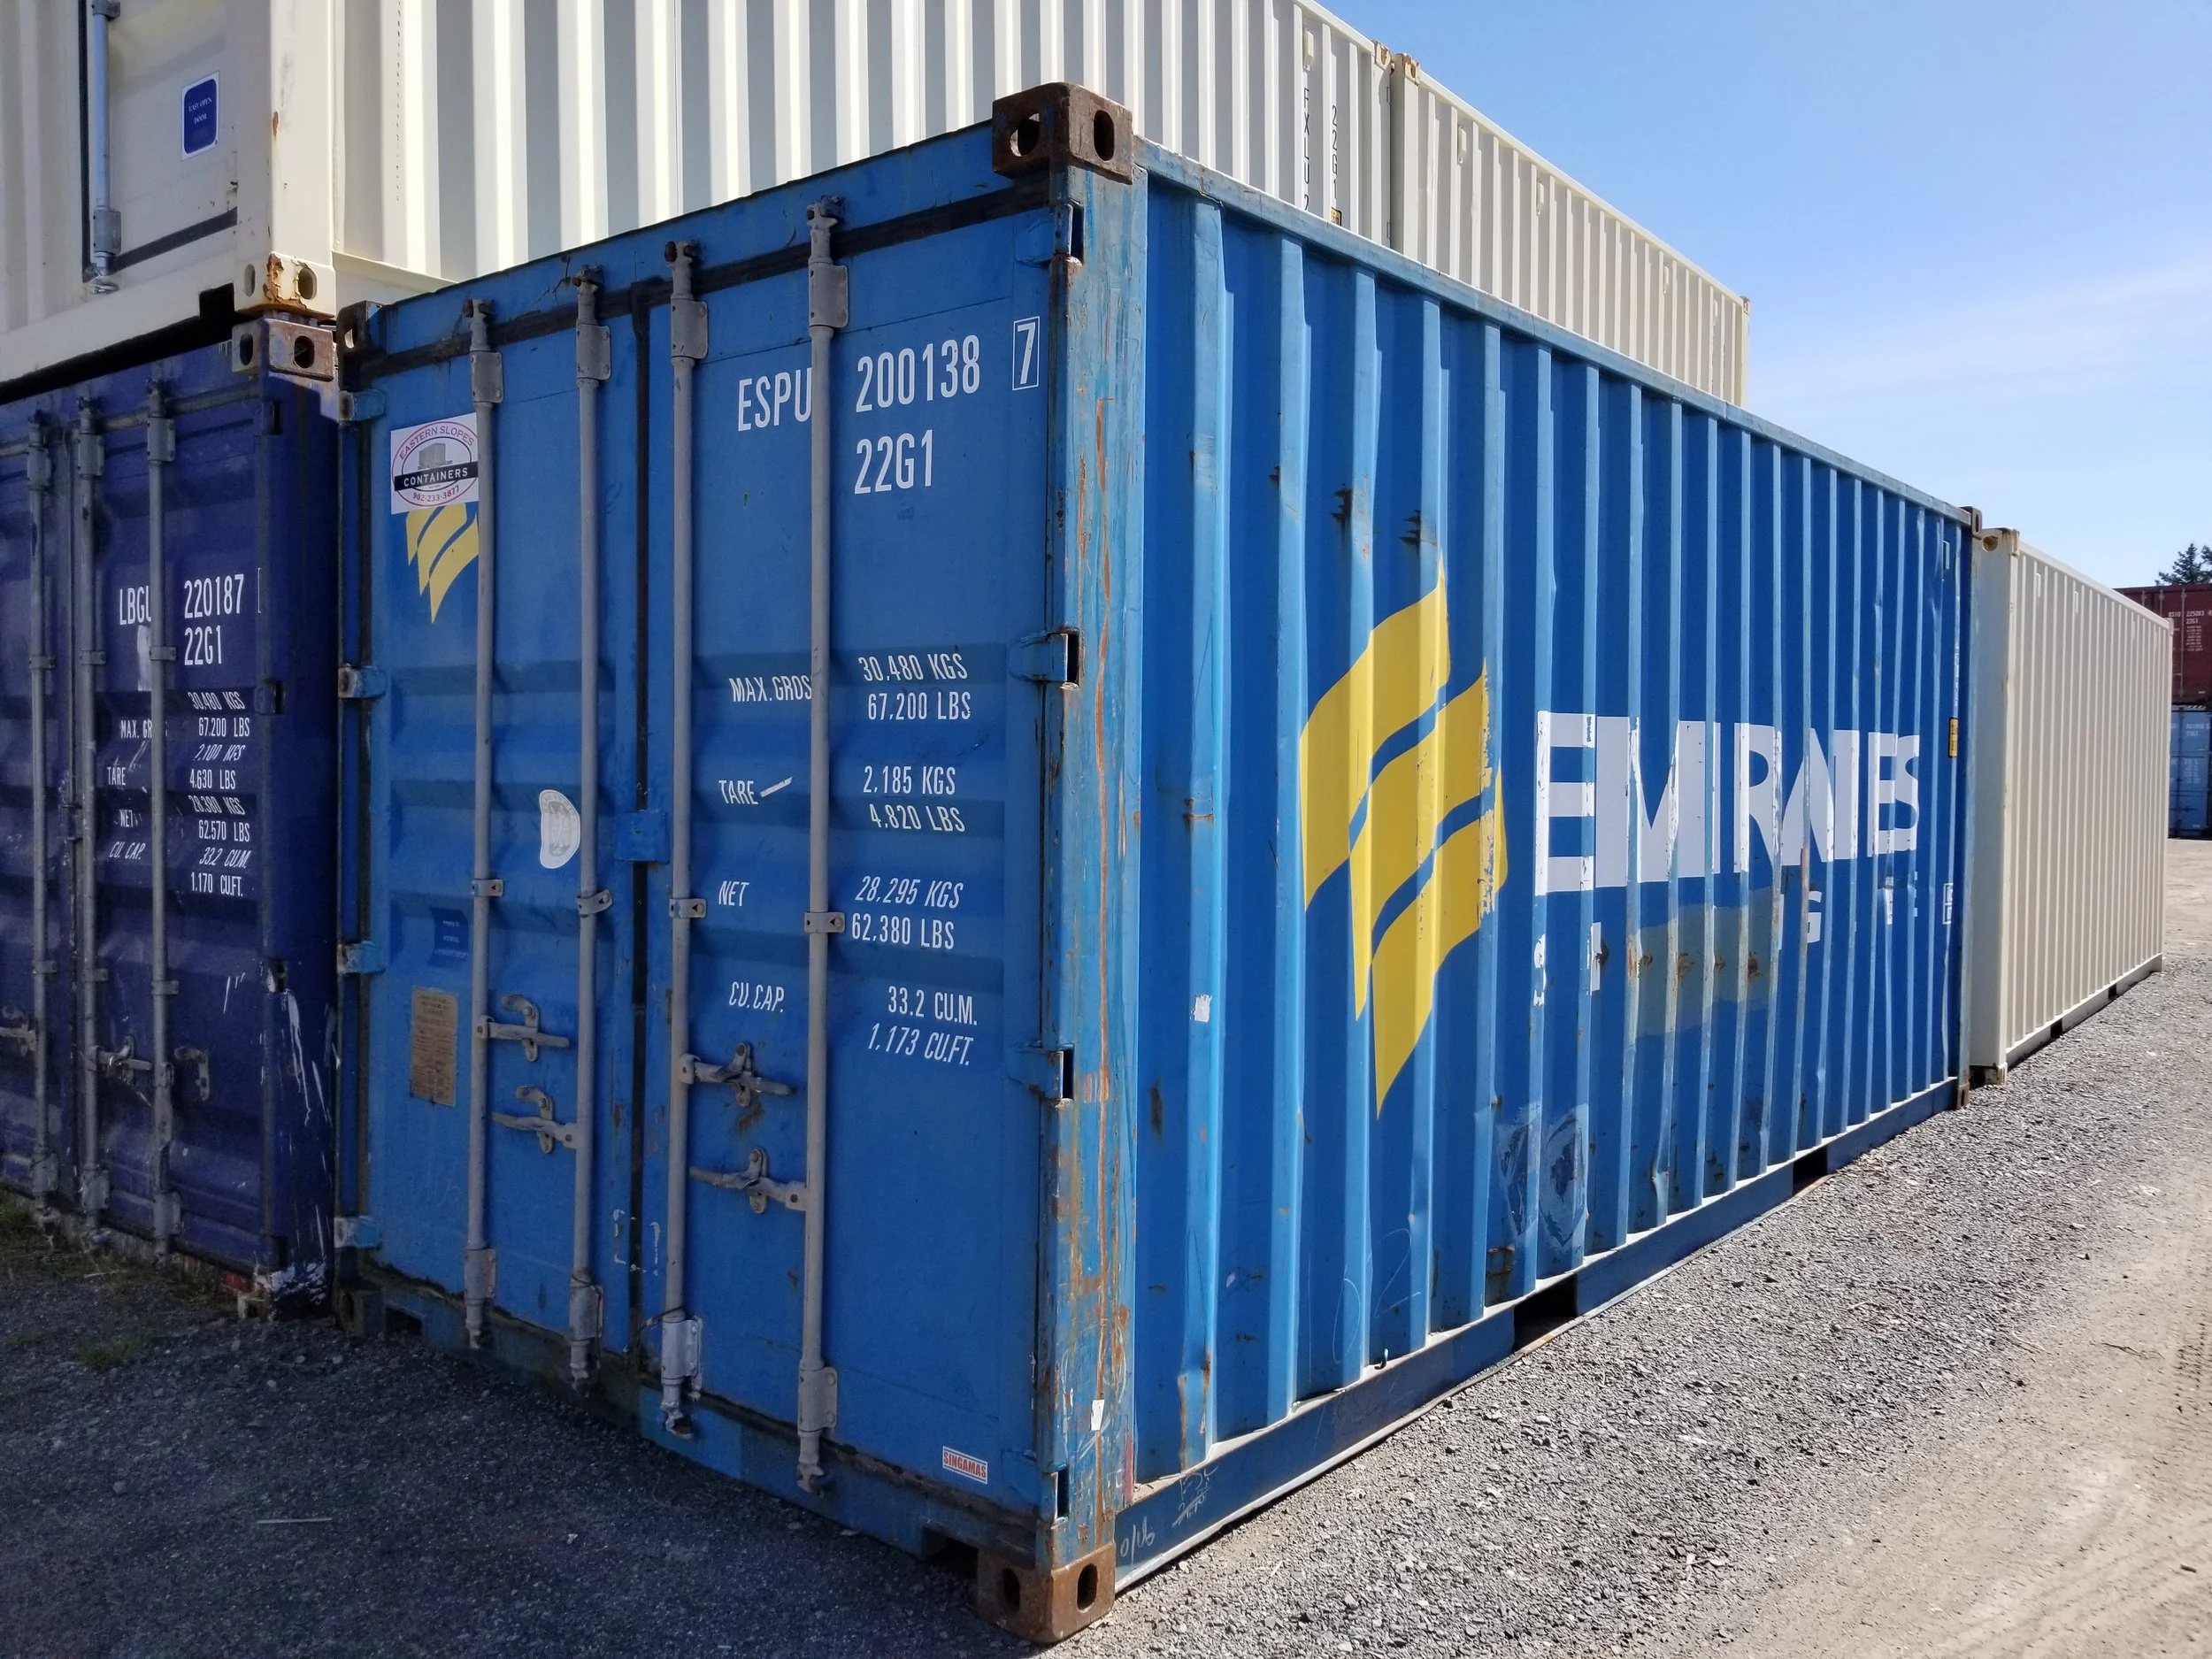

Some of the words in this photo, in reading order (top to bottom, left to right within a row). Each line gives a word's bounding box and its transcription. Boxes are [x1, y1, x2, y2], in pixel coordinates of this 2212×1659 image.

[738, 368, 811, 431] ESPU
[856, 335, 979, 412] 200138
[1017, 321, 1036, 385] 7
[399, 426, 438, 460] EASTERN
[439, 426, 475, 446] SLOPES
[855, 430, 933, 494] 22G1
[403, 467, 468, 487] CONTAINERS
[185, 574, 244, 618] 220187
[185, 626, 222, 665] 22G1
[927, 654, 968, 680] KGS
[223, 692, 245, 710] KGS
[869, 693, 927, 719] 67,200
[938, 692, 971, 719] LBS
[234, 718, 250, 737] LBS
[107, 766, 127, 786] TARE
[219, 770, 235, 789] LBS
[864, 765, 911, 794] 2,185
[922, 766, 956, 795] KGS
[223, 796, 246, 815] KGS
[718, 780, 758, 805] TARE
[234, 822, 250, 841] LBS
[926, 805, 965, 832] LBS
[718, 880, 749, 906] NET
[855, 876, 920, 905] 28,295
[925, 880, 964, 908] KGS
[852, 912, 911, 945] 62,380
[920, 918, 954, 949] LBS
[888, 986, 925, 1018] 33.2
[934, 992, 978, 1025] CU.M.
[925, 1032, 974, 1065] CU.FT.
[943, 1452, 987, 1479] SINGAMAS
